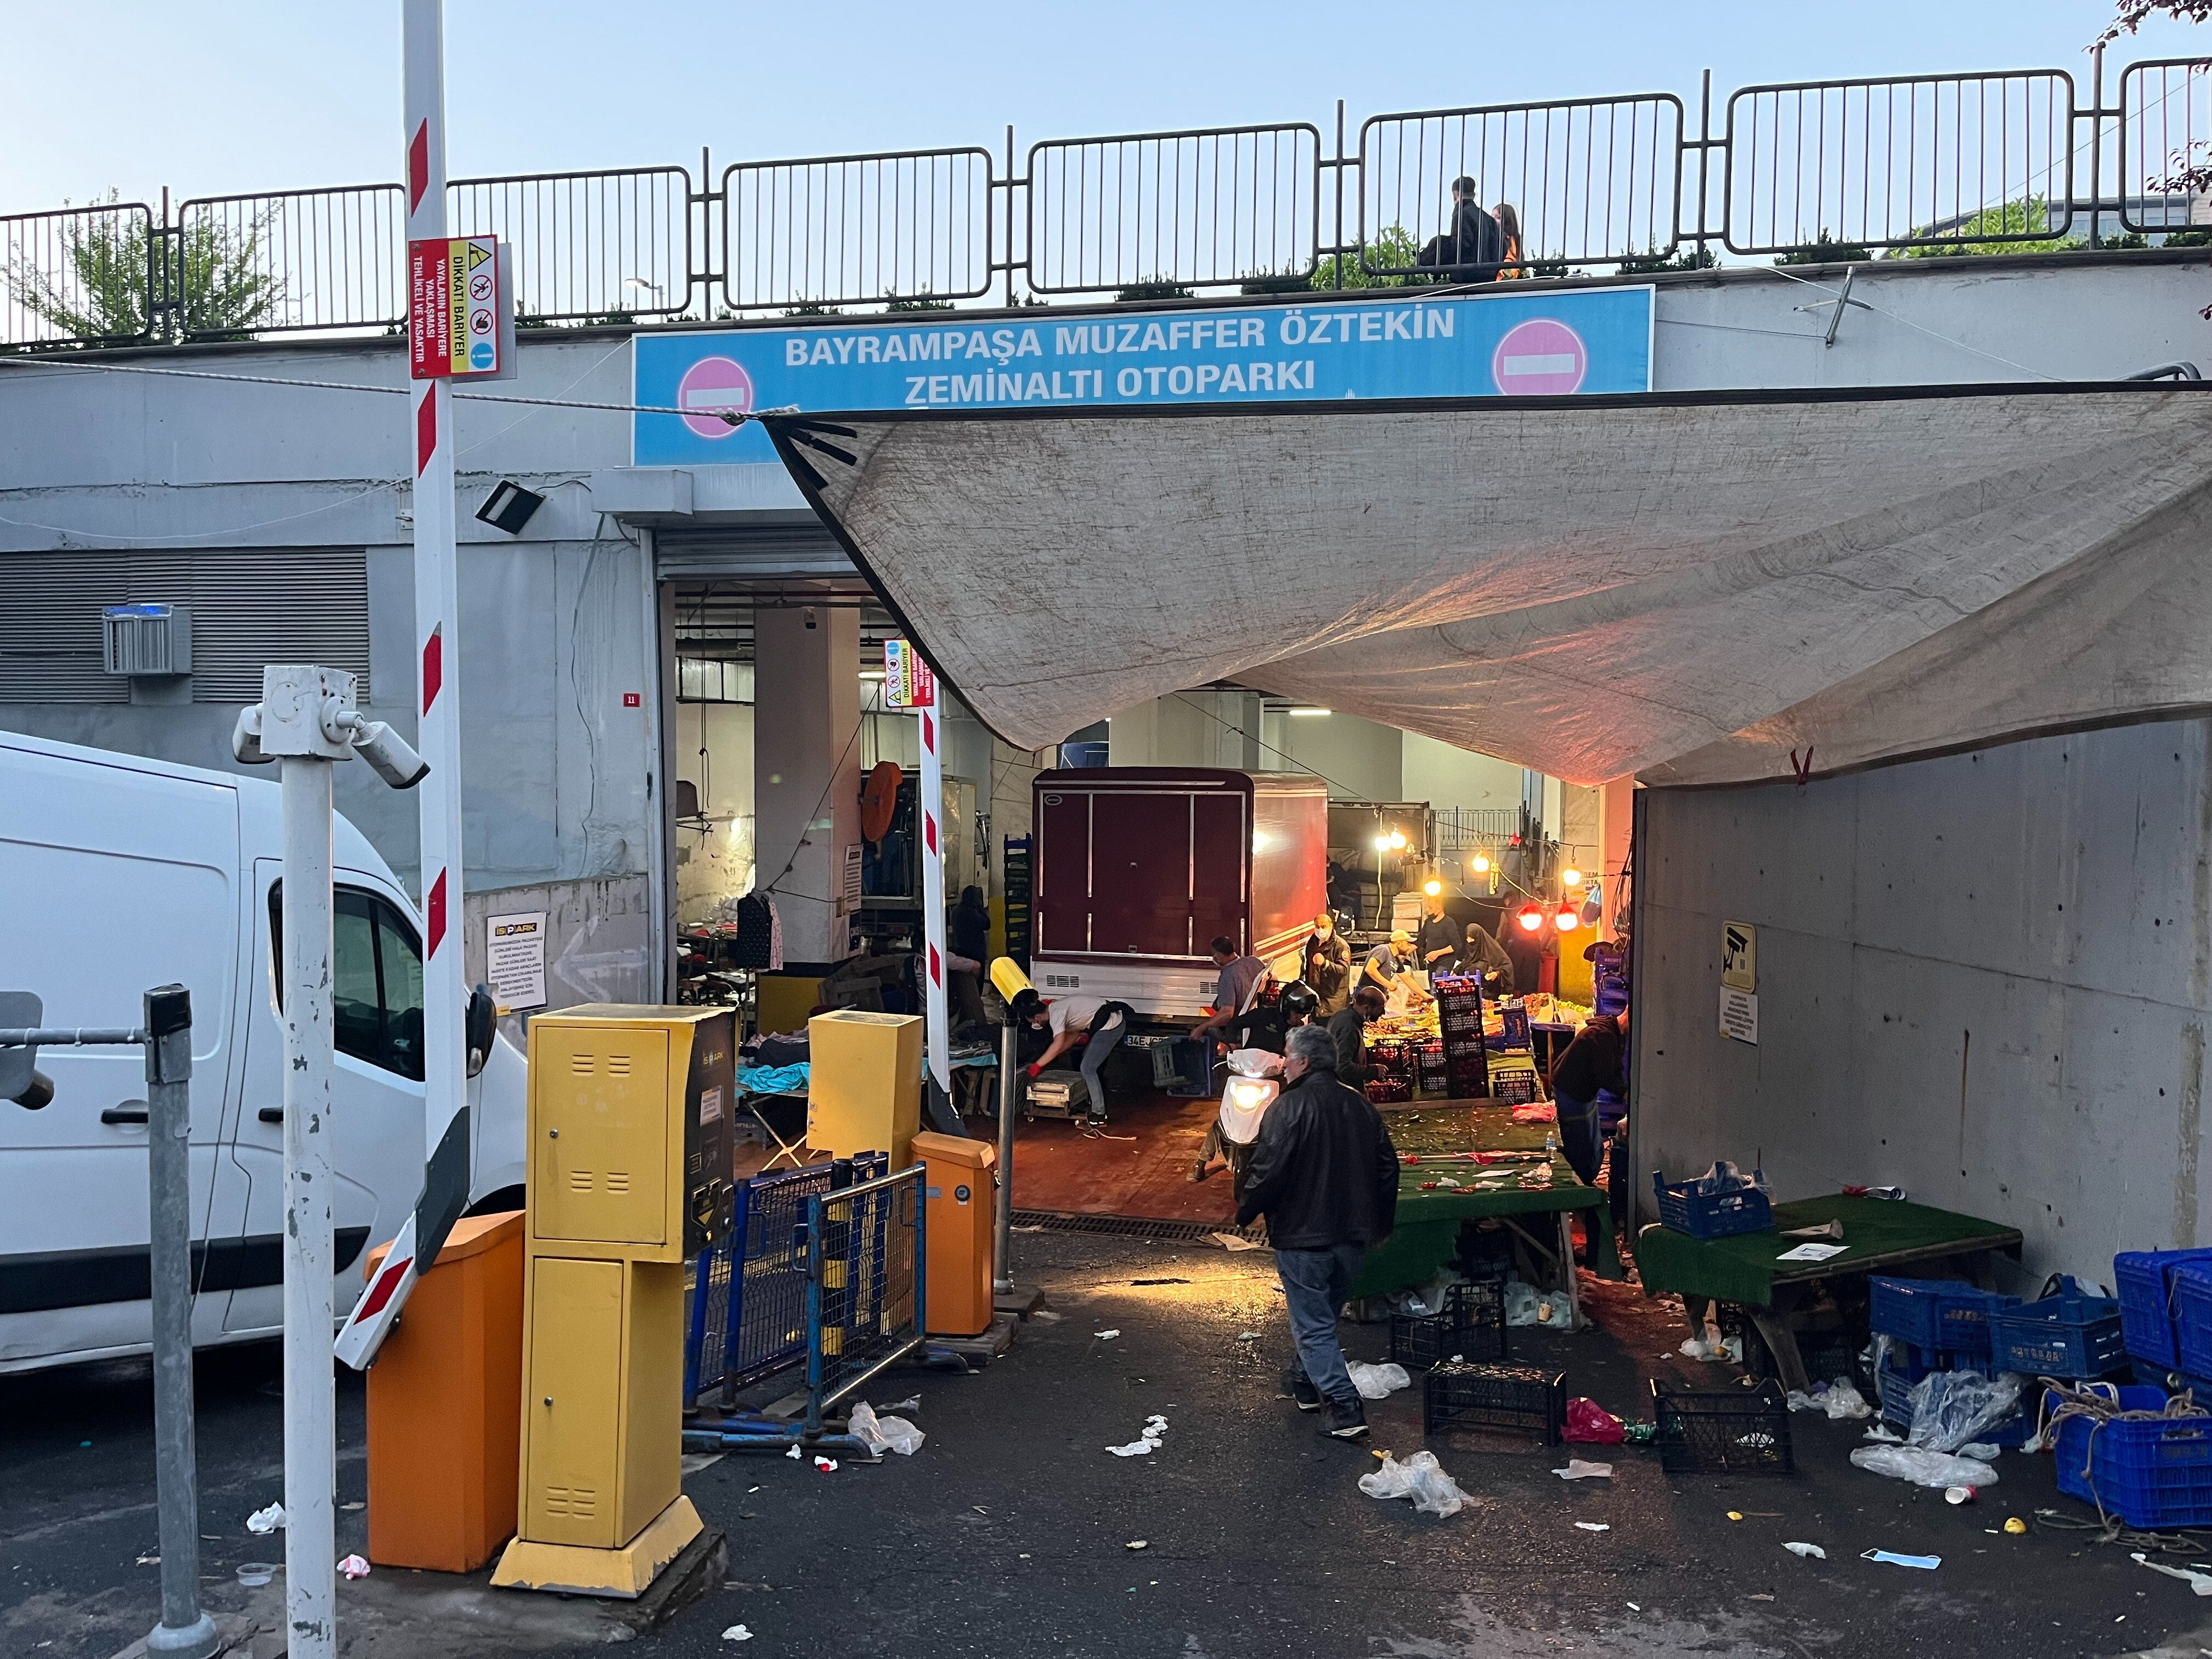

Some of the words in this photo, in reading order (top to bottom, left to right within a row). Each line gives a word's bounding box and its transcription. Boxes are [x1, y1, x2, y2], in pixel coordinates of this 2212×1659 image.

[414, 256, 425, 301] TEHLİKELİ
[437, 258, 446, 309] YAYALARIN
[453, 256, 465, 302] DİKKAT!
[414, 303, 423, 316] VE
[424, 279, 436, 338] YAKLAŞMASI
[454, 306, 467, 357] BARİYER
[415, 318, 425, 363] YASAKTIR
[437, 311, 448, 357] BARİYERE
[786, 329, 1043, 366] BAYRAMPAŞA
[1056, 318, 1265, 355] MUZAFFER
[1280, 303, 1454, 345] ÖZTEKİN
[905, 368, 1102, 404] ZEMİNALTI
[1117, 360, 1314, 397] OTOPARKI
